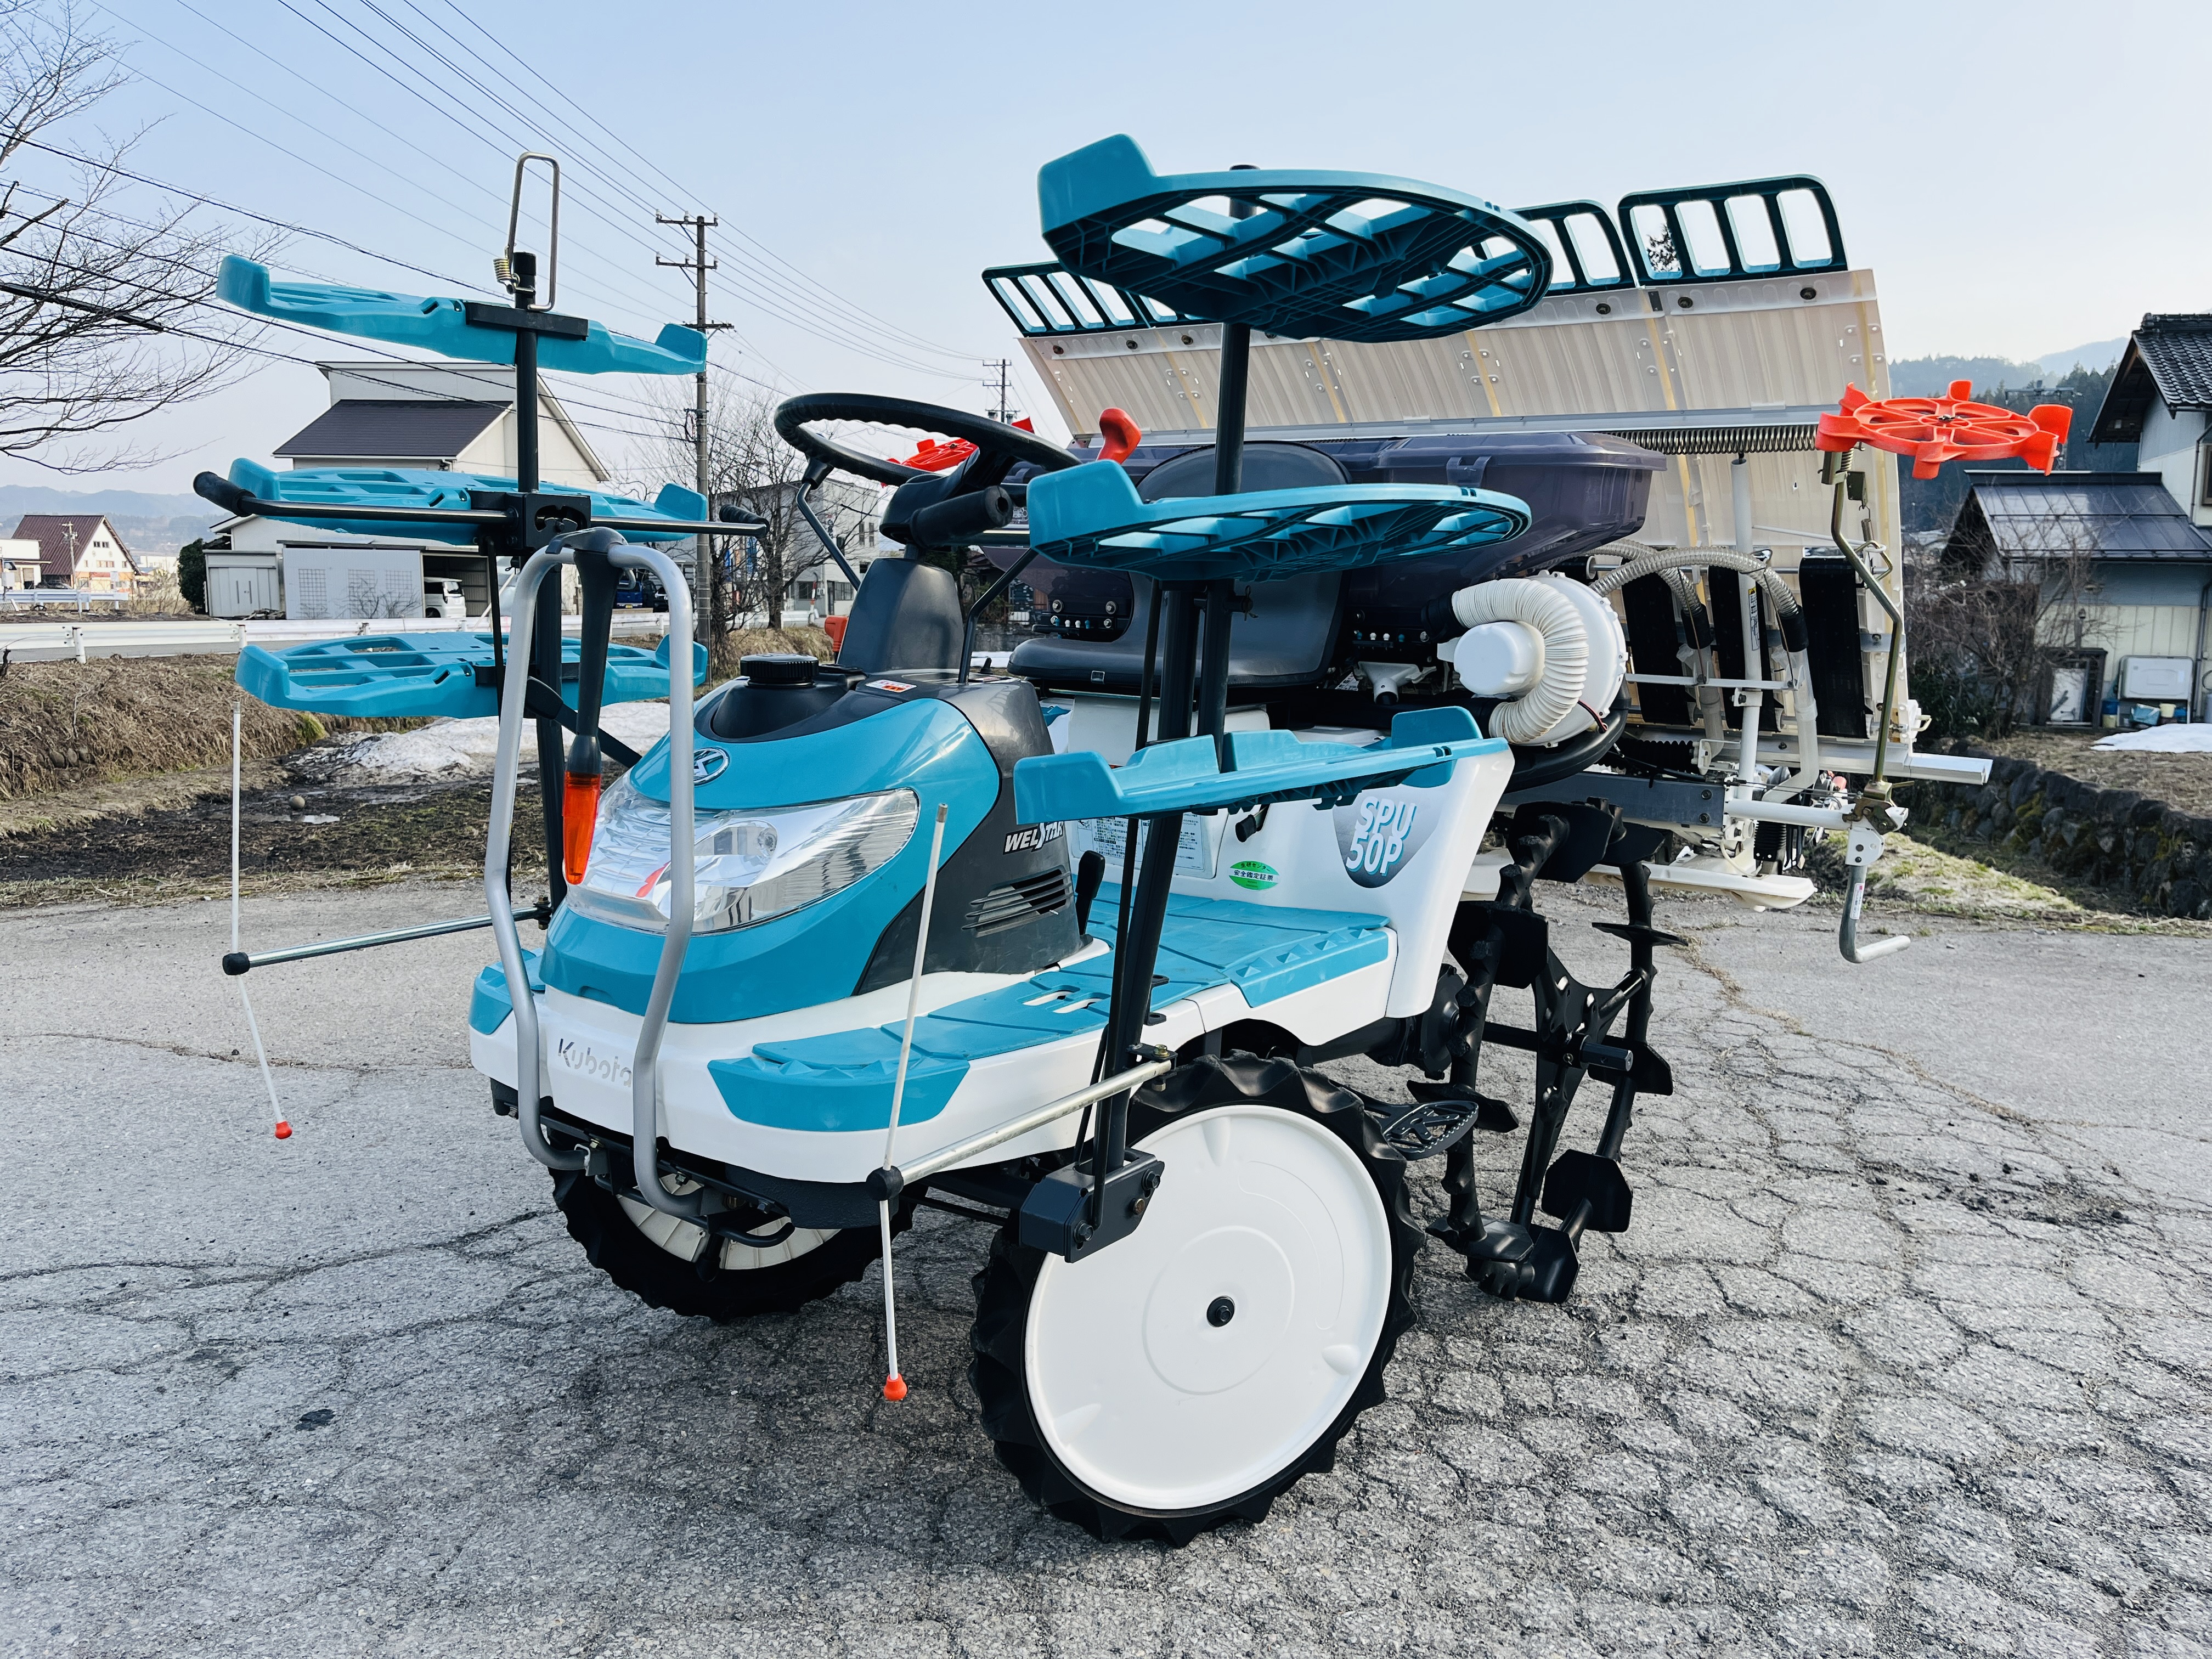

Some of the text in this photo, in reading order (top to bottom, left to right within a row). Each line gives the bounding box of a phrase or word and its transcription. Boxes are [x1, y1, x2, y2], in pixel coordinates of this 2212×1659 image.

[1005, 821, 1064, 853] WELSTAR
[1355, 796, 1417, 840] SPU
[1240, 862, 1271, 872] 生研センター
[1346, 831, 1404, 877] 50P
[1234, 870, 1274, 881] 安全鑑定証票
[558, 1038, 633, 1088] Kubota
